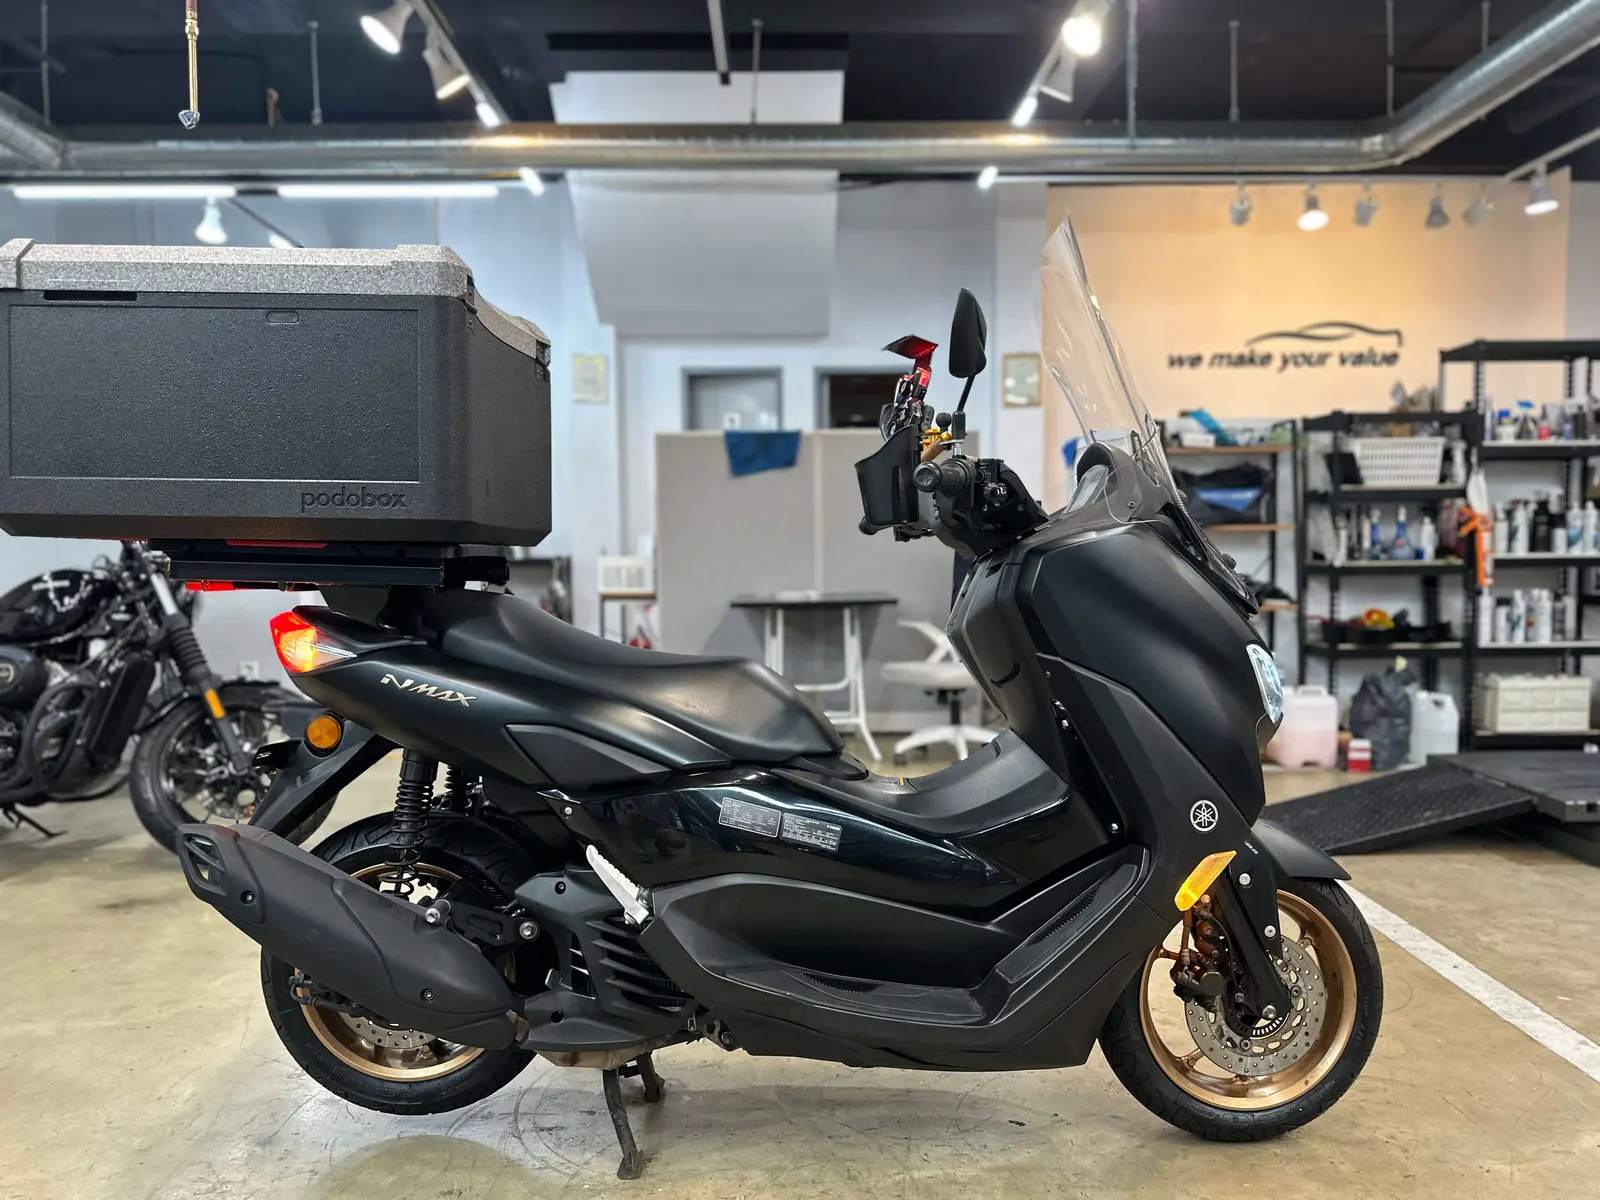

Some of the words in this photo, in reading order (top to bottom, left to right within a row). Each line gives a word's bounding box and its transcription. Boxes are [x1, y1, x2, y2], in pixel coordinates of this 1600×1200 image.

[1167, 352, 1202, 368] we
[1208, 349, 1273, 368] make
[1277, 351, 1332, 374] your
[1338, 348, 1399, 368] value
[301, 486, 407, 514] podobox
[380, 673, 477, 707] NMAX
